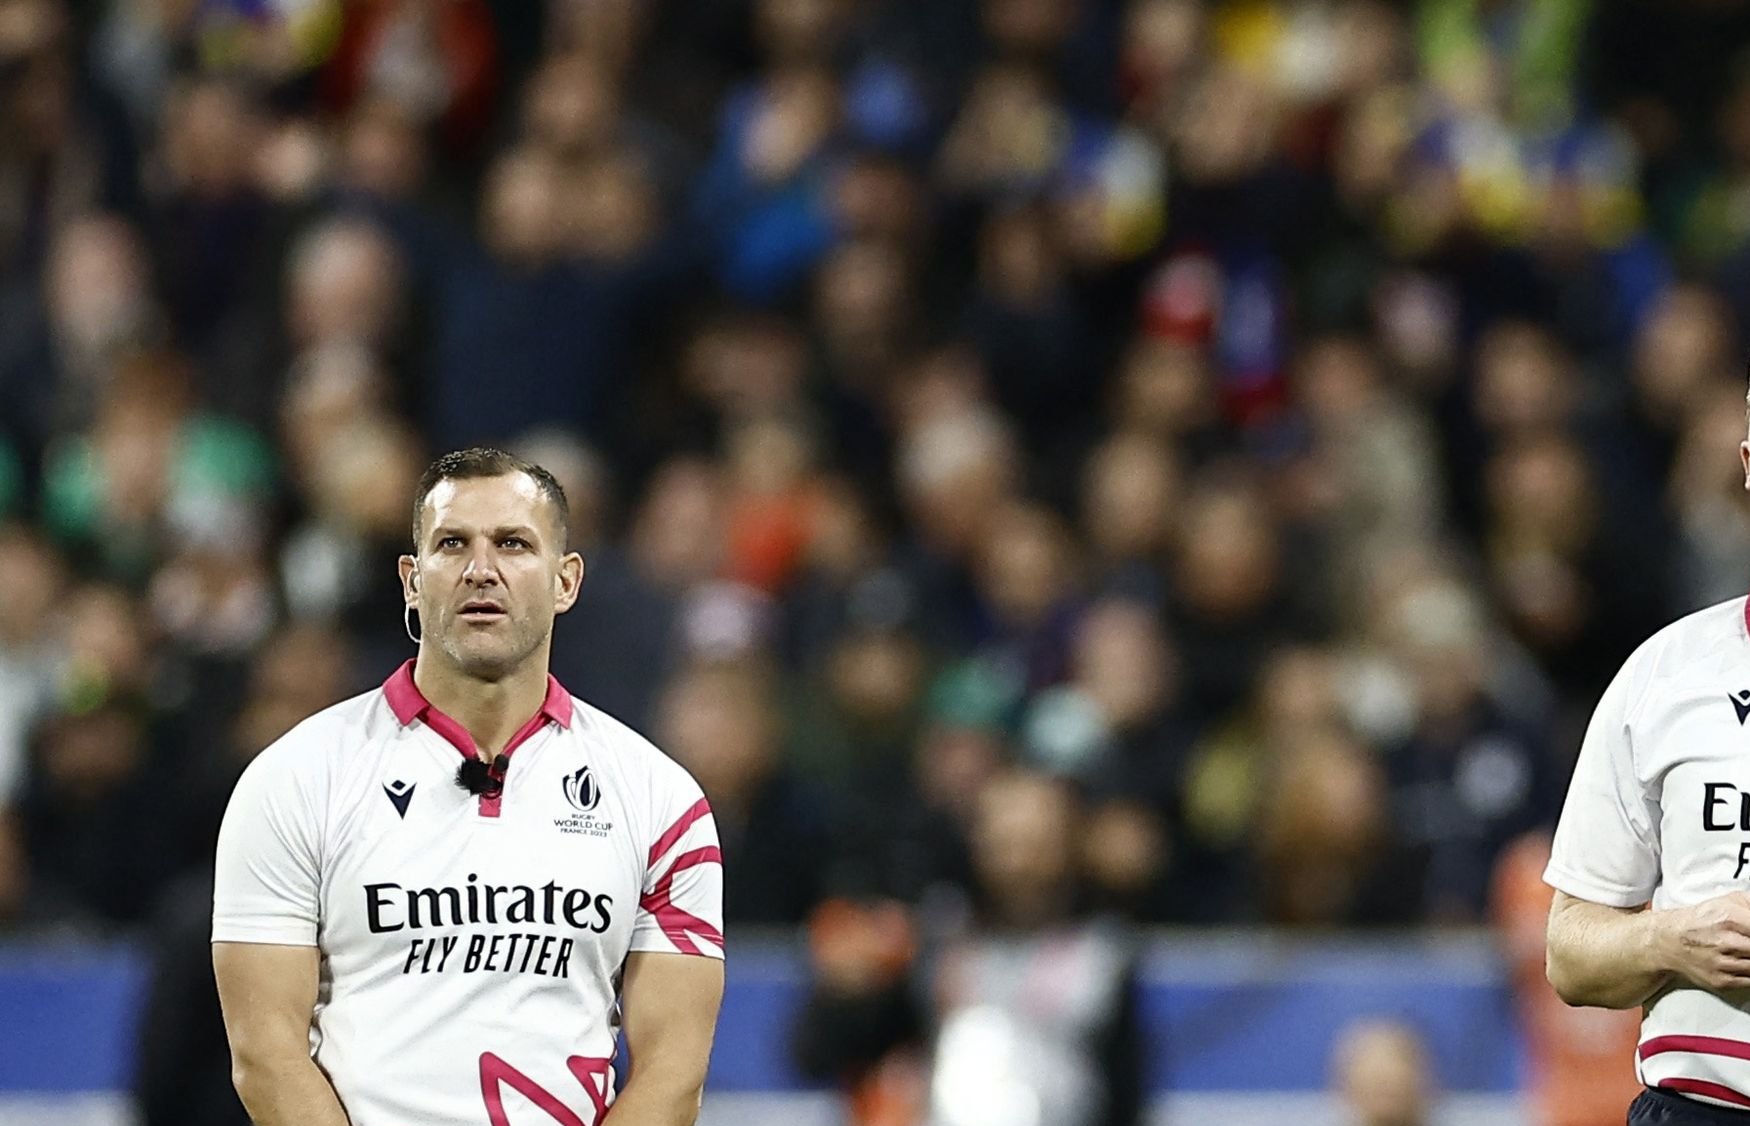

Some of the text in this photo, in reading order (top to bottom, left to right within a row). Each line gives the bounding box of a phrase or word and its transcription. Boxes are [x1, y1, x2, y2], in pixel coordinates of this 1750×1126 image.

[553, 819, 614, 831] WORLD CUP
[363, 873, 613, 934] Emirates
[403, 933, 574, 978] FLY BETTER
